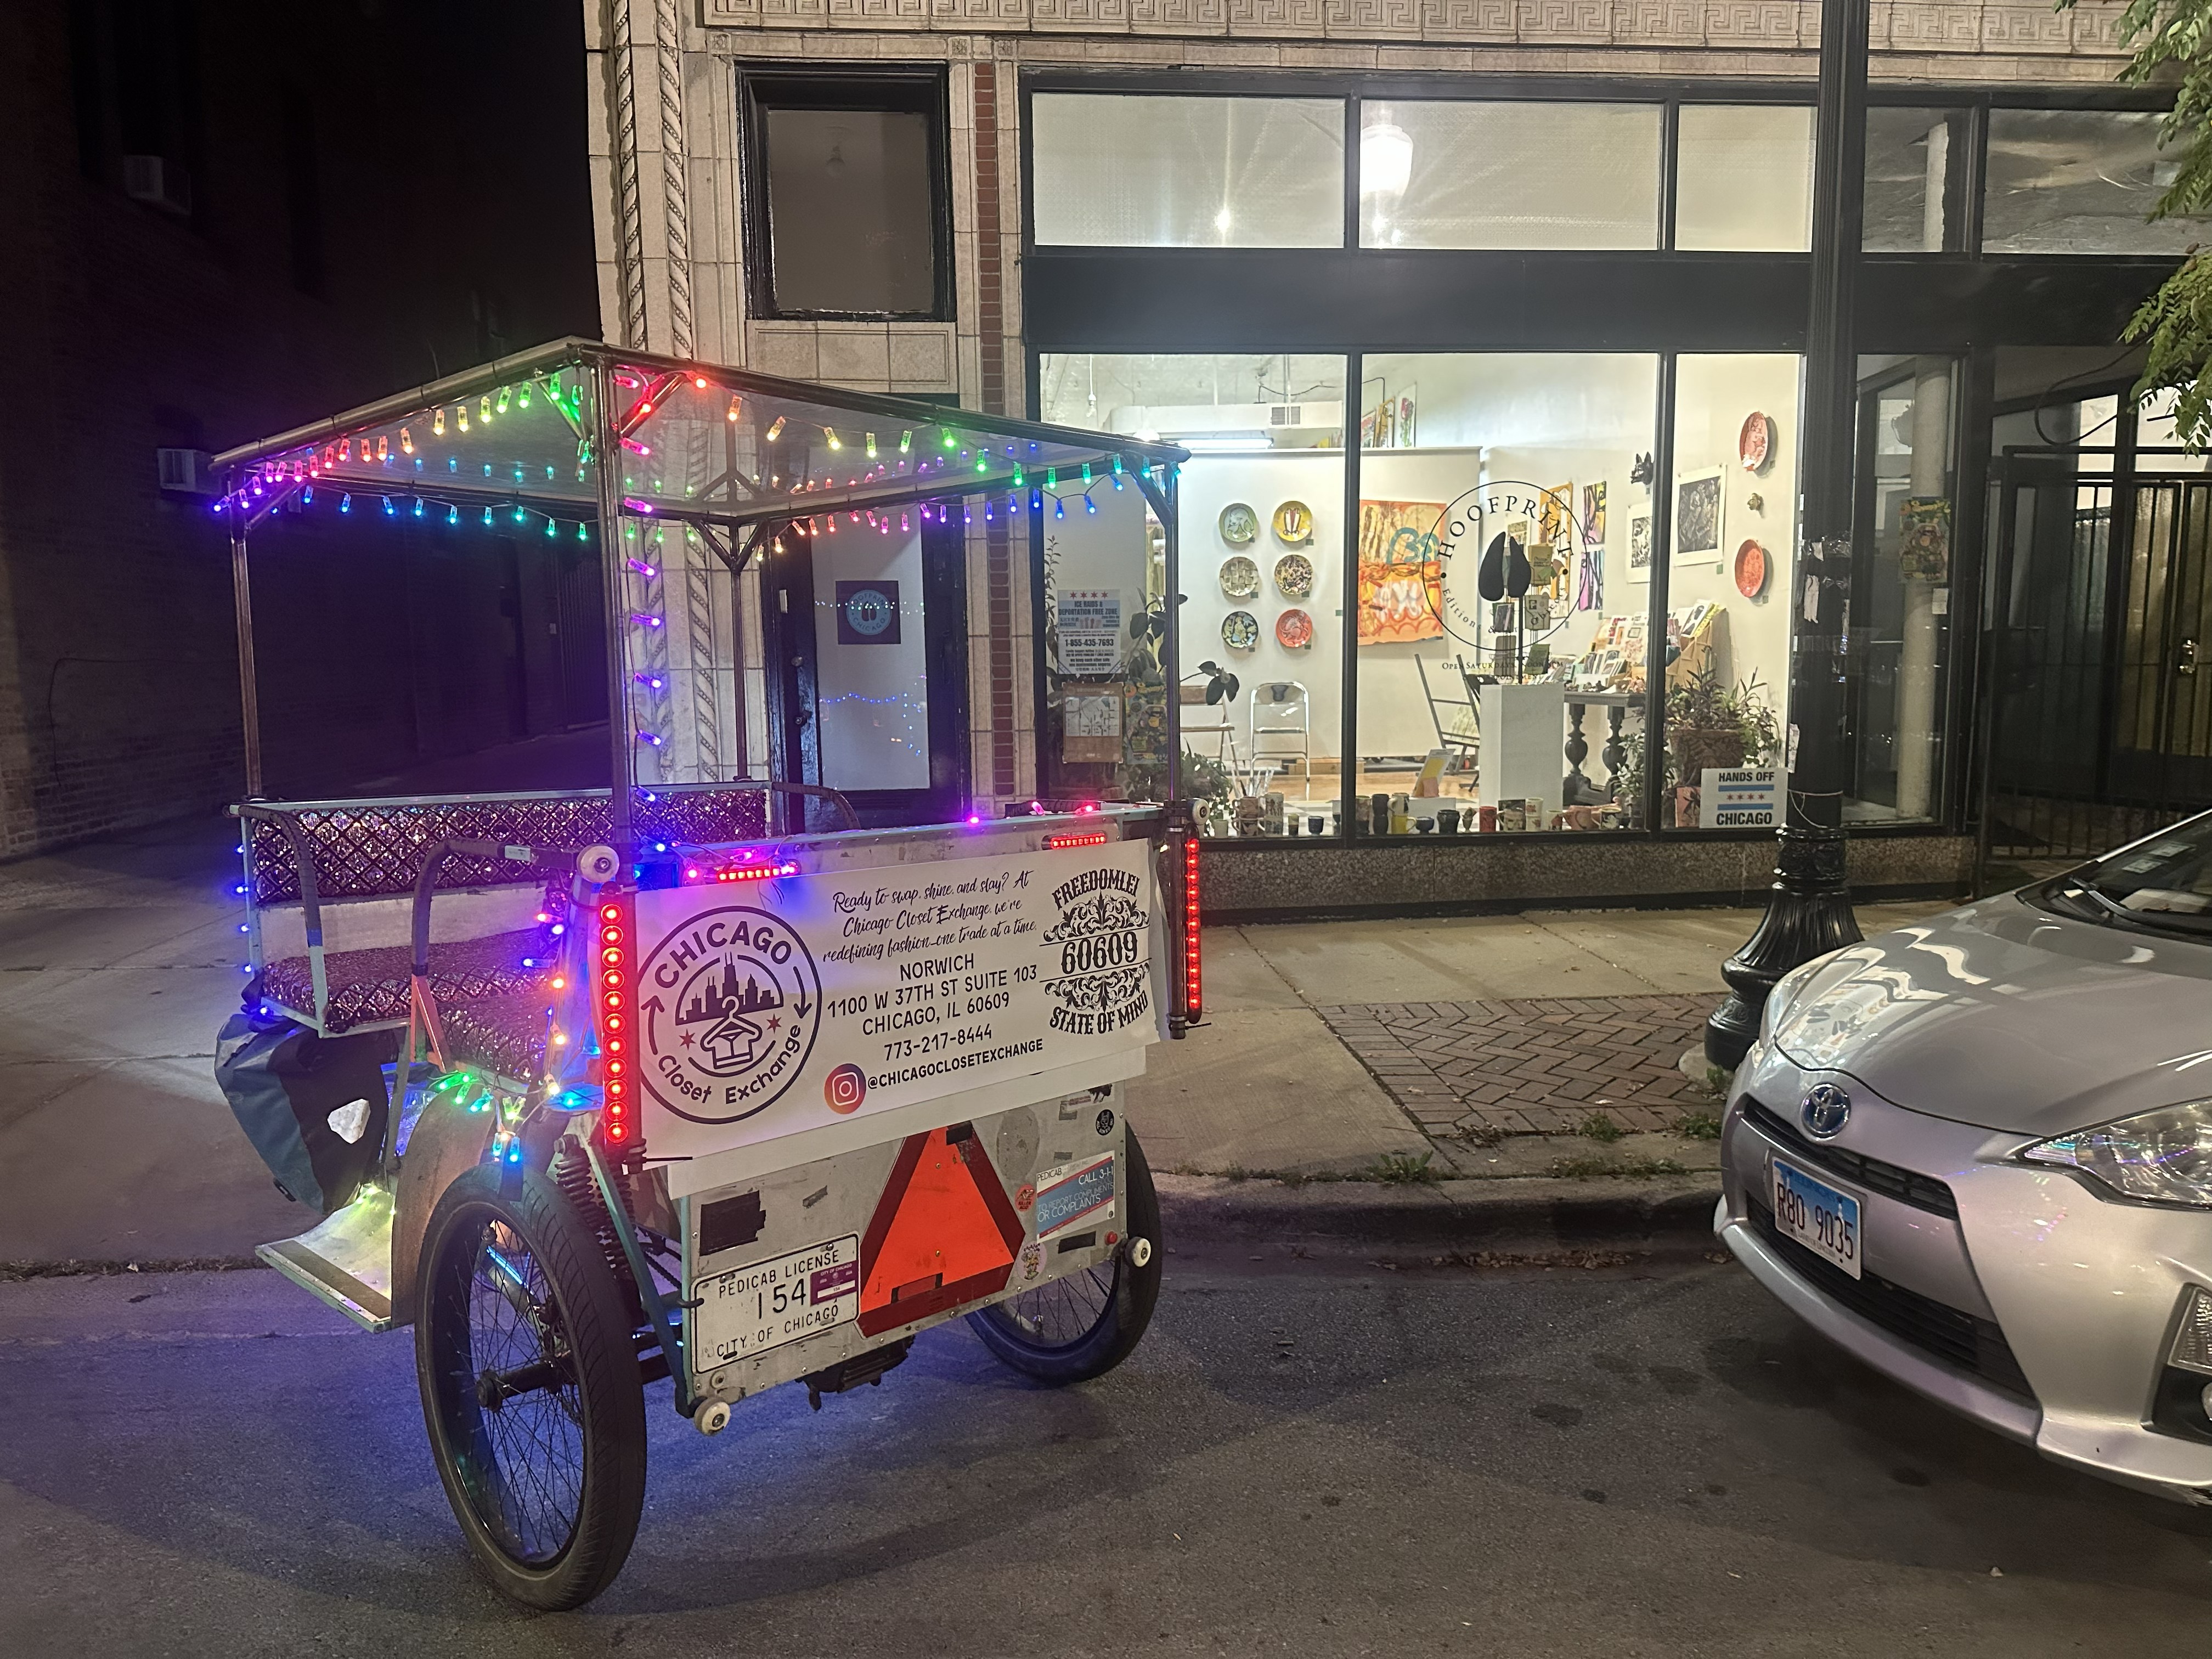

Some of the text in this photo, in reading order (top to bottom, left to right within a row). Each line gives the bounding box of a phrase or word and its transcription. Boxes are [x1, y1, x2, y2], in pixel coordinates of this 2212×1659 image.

[1437, 496, 1574, 561] HOOFPRINT
[853, 617, 885, 631] CHICAGO
[1442, 588, 1482, 629] Editions
[1718, 771, 1775, 782] HANDS OFF
[1716, 812, 1773, 825] CHICAGO
[833, 891, 872, 913] Ready
[875, 888, 890, 905] to
[957, 878, 977, 894] and
[980, 872, 1009, 894] slay?
[1013, 870, 1034, 889] At
[823, 943, 884, 963] redefining
[959, 925, 988, 943] trade
[990, 921, 1007, 937] at
[1003, 925, 1011, 935] a
[843, 917, 894, 937] Chicago
[896, 906, 938, 929] Closet
[655, 921, 791, 988] CHICAGO
[900, 953, 974, 981] NORWICH
[1061, 931, 1137, 974] 60609
[827, 964, 1037, 1018] 1100 W 37TH ST SUITE 103
[863, 991, 1009, 1036] CHICAGO, IL 60609
[1049, 990, 1148, 1035] STATE OF MIND
[884, 1023, 992, 1062] 773-217-8444
[658, 1025, 800, 1104] Closet Exchange
[867, 1038, 1043, 1090] @CHICAGOCLOSETEXCHANGE
[1037, 1167, 1062, 1182] PEDICAB
[1079, 1172, 1097, 1185] CALL
[1037, 1204, 1047, 1212] TO
[1049, 1195, 1072, 1209] REPORT
[1037, 1210, 1049, 1222] OR
[1052, 1193, 1101, 1217] COMPLAINTS
[1778, 1182, 1854, 1260] R80 9035
[719, 1250, 839, 1298] PEDICAB LICENSE
[758, 1278, 806, 1319] 154
[717, 1305, 838, 1357] CITY OF CHICAGO
